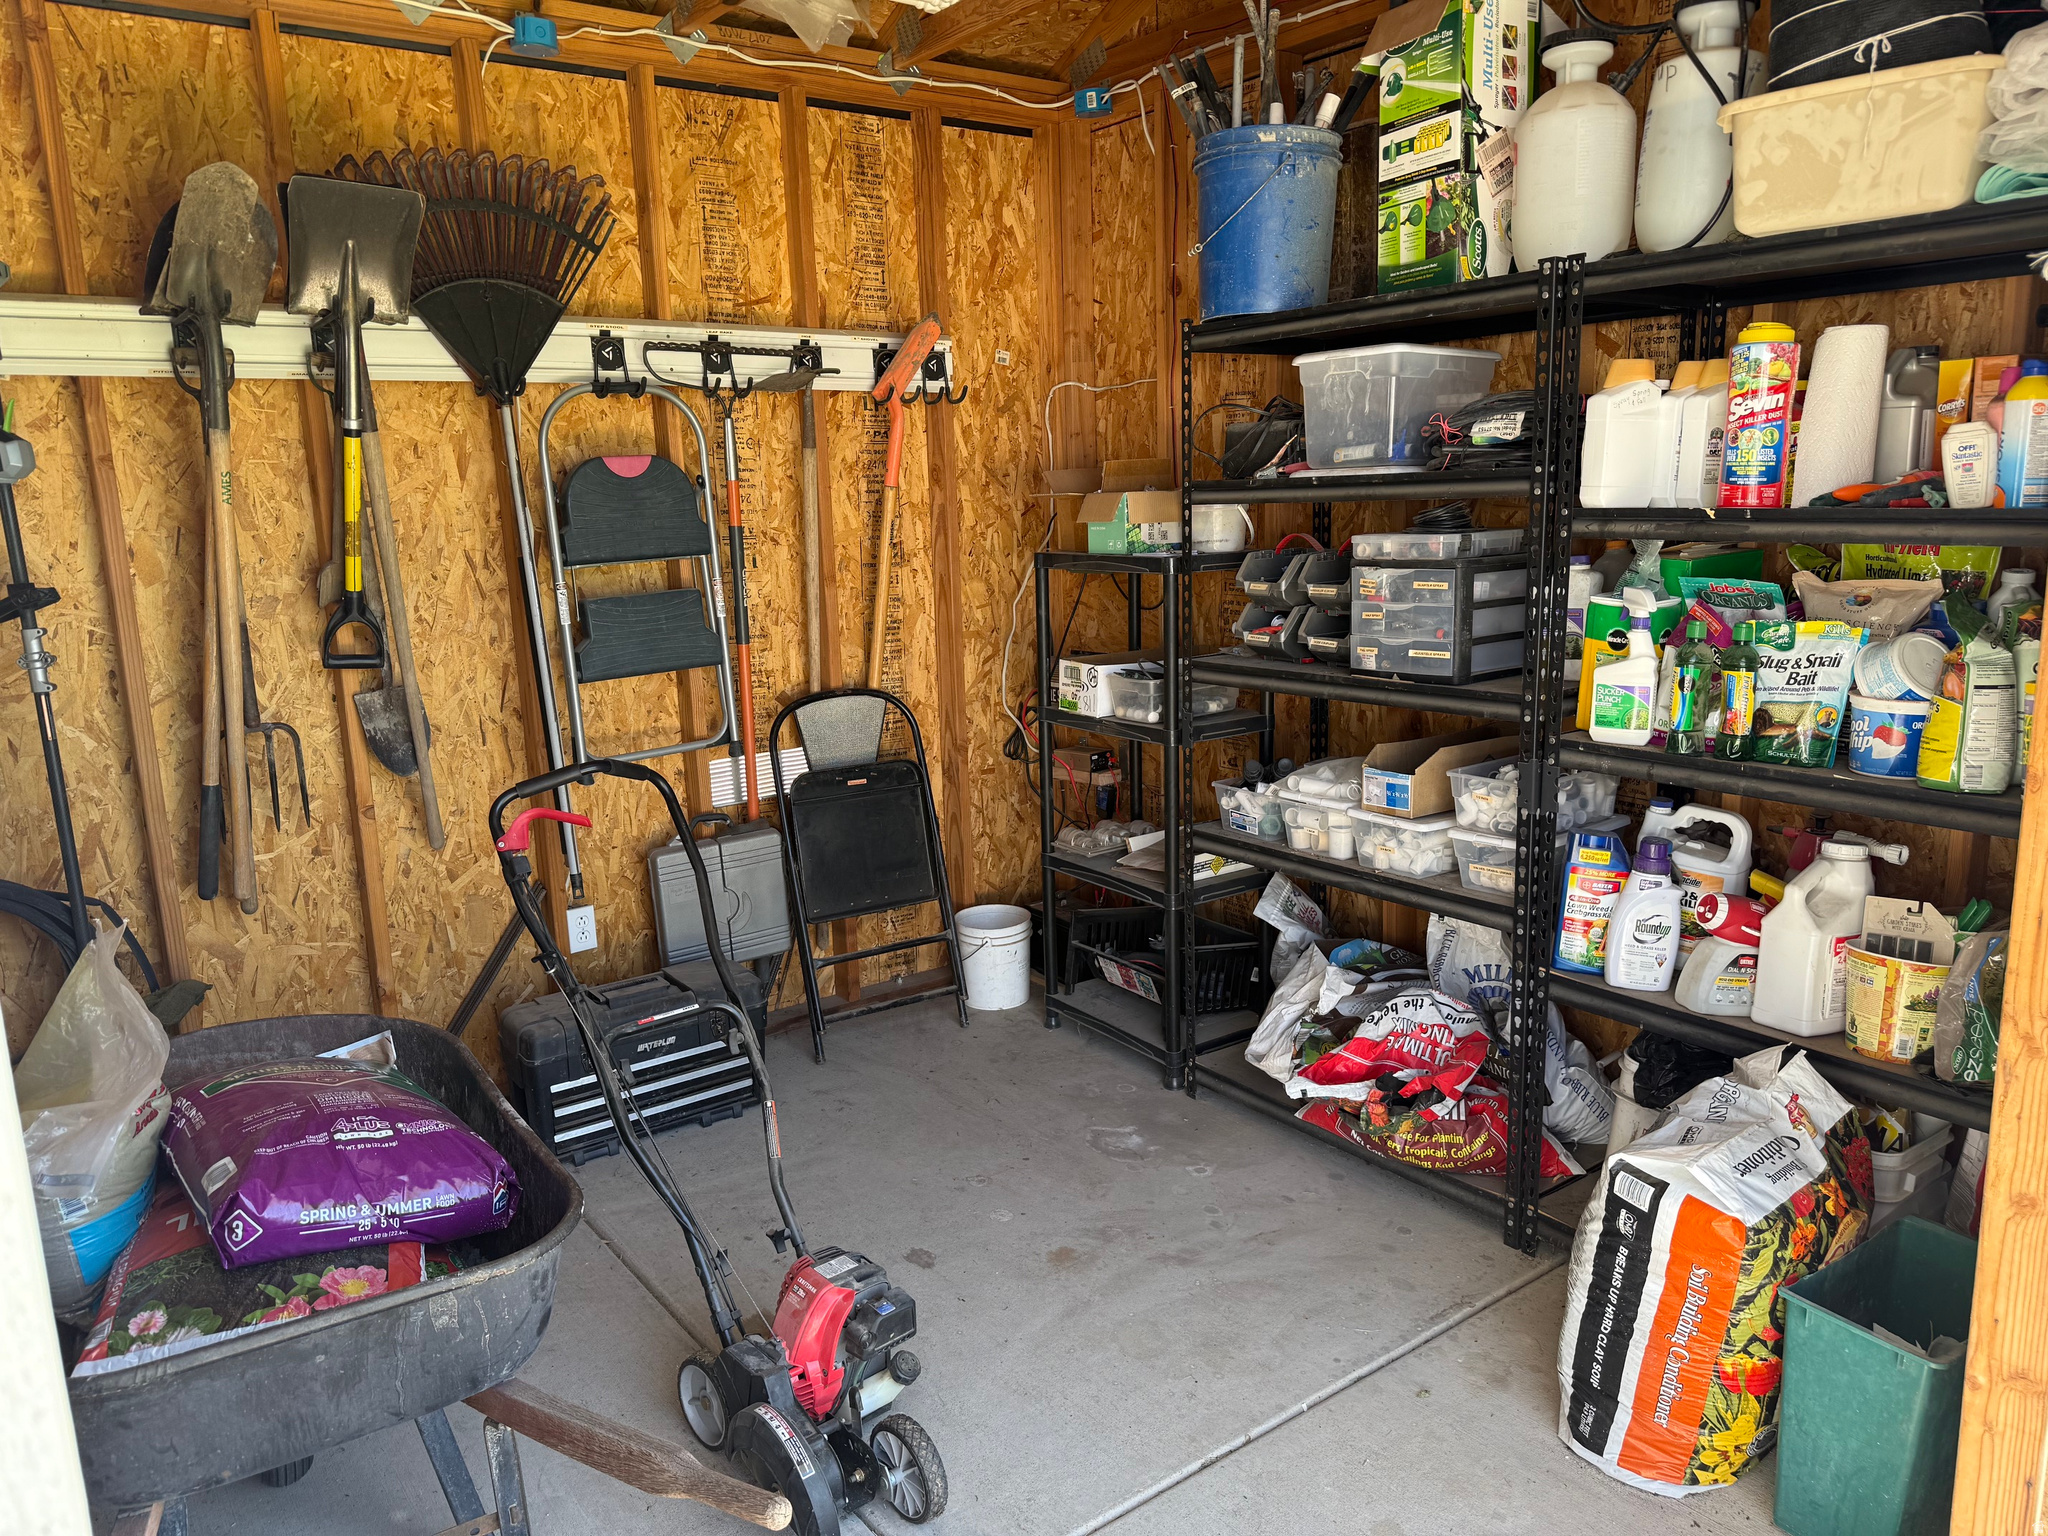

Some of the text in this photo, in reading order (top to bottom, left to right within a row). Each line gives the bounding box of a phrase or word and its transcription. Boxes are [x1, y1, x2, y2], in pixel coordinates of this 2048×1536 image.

[1422, 30, 1454, 46] Multi-Use
[1482, 0, 1494, 90] Multi-Use
[1727, 392, 1785, 422] Sevin
[2033, 404, 2045, 413] 50
[1744, 413, 1767, 425] KILLER
[1768, 410, 1784, 420] DUST
[1737, 449, 1757, 462] 150
[1958, 444, 1978, 452] OFF!
[1951, 451, 1983, 461] Skintastic
[221, 471, 232, 505] AMES
[1865, 563, 1900, 581] Hydrated
[1701, 590, 1768, 608] ORGANICS
[1824, 624, 1851, 636] Kills
[1757, 653, 1843, 674] Slug & Snail
[1785, 670, 1819, 686] Bait
[1597, 686, 1625, 696] SUCKER
[1597, 694, 1621, 703] PUNCH
[1766, 750, 1799, 759] SCHULTZ
[1567, 901, 1588, 909] Lawn
[1588, 904, 1607, 912] Weed
[1570, 895, 1600, 903] All-in-One
[1566, 908, 1603, 918] Crabgrass
[1634, 919, 1672, 938] Roundup
[1905, 921, 1922, 929] STAKES
[1403, 998, 1424, 1012] the
[1953, 1049, 1964, 1070] Scotts
[1560, 1077, 1610, 1123] BLUE RIBBO
[1415, 1133, 1429, 1142] For
[284, 1142, 300, 1150] REACH
[1404, 1131, 1490, 1160] Tropicals, Container
[1435, 1160, 1455, 1169] And
[1764, 1159, 1803, 1185] Building
[435, 1193, 455, 1202] LAWN
[436, 1199, 456, 1208] FOOD
[300, 1196, 432, 1225] SPRING & UMMER
[232, 1221, 243, 1241] 3
[358, 1219, 372, 1232] 25
[348, 1235, 362, 1243] NET
[362, 1234, 374, 1242] WT.
[1611, 1245, 1629, 1287] BREAKS
[797, 1276, 818, 1294] CRAFTSMAN
[1607, 1288, 1618, 1304] UP
[1600, 1304, 1614, 1333] HARD
[1593, 1333, 1608, 1363] CLAY
[1652, 1263, 1713, 1429] Soil Building Conditioner
